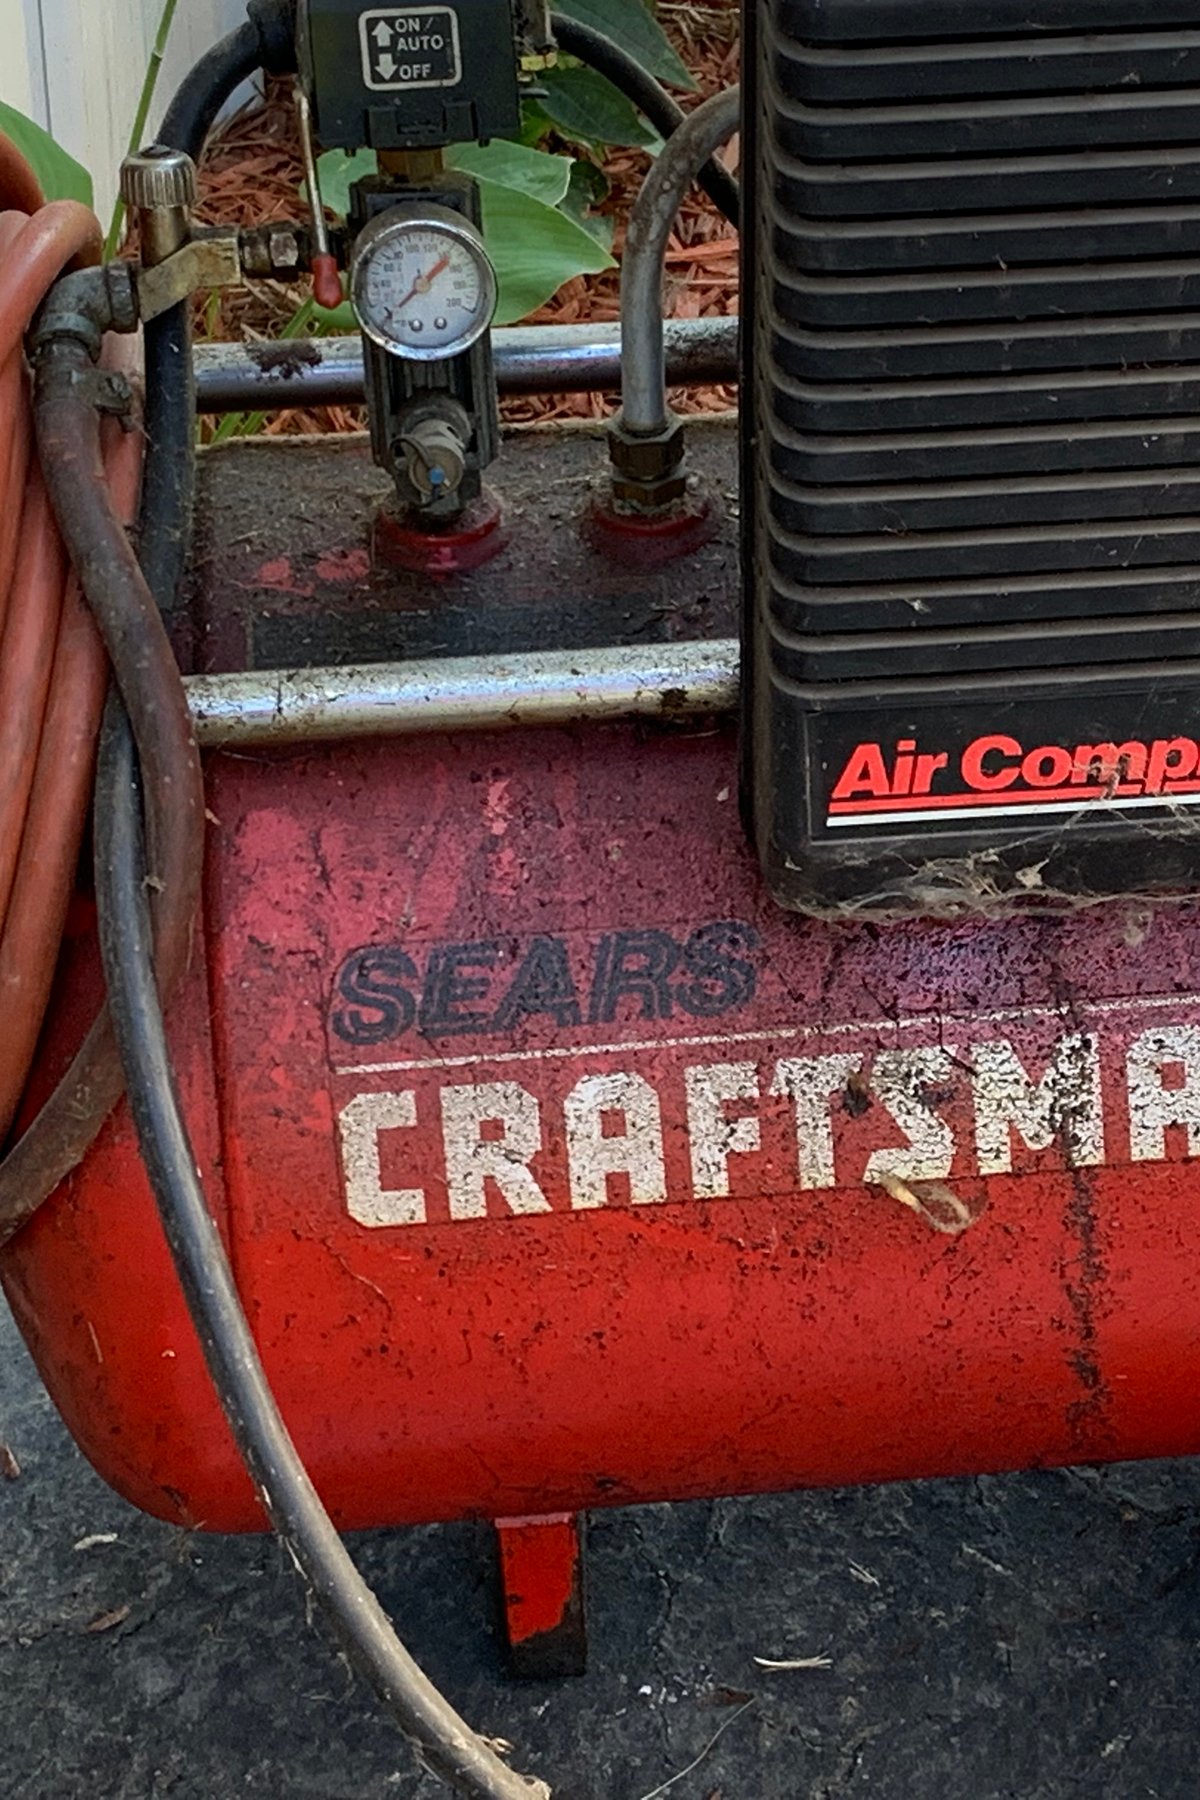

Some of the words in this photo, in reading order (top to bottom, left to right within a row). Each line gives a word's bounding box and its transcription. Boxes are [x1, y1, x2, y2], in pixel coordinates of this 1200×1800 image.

[397, 35, 444, 51] AUTO
[400, 63, 432, 79] OFF
[831, 738, 947, 799] Air
[331, 918, 761, 1046] SEARS
